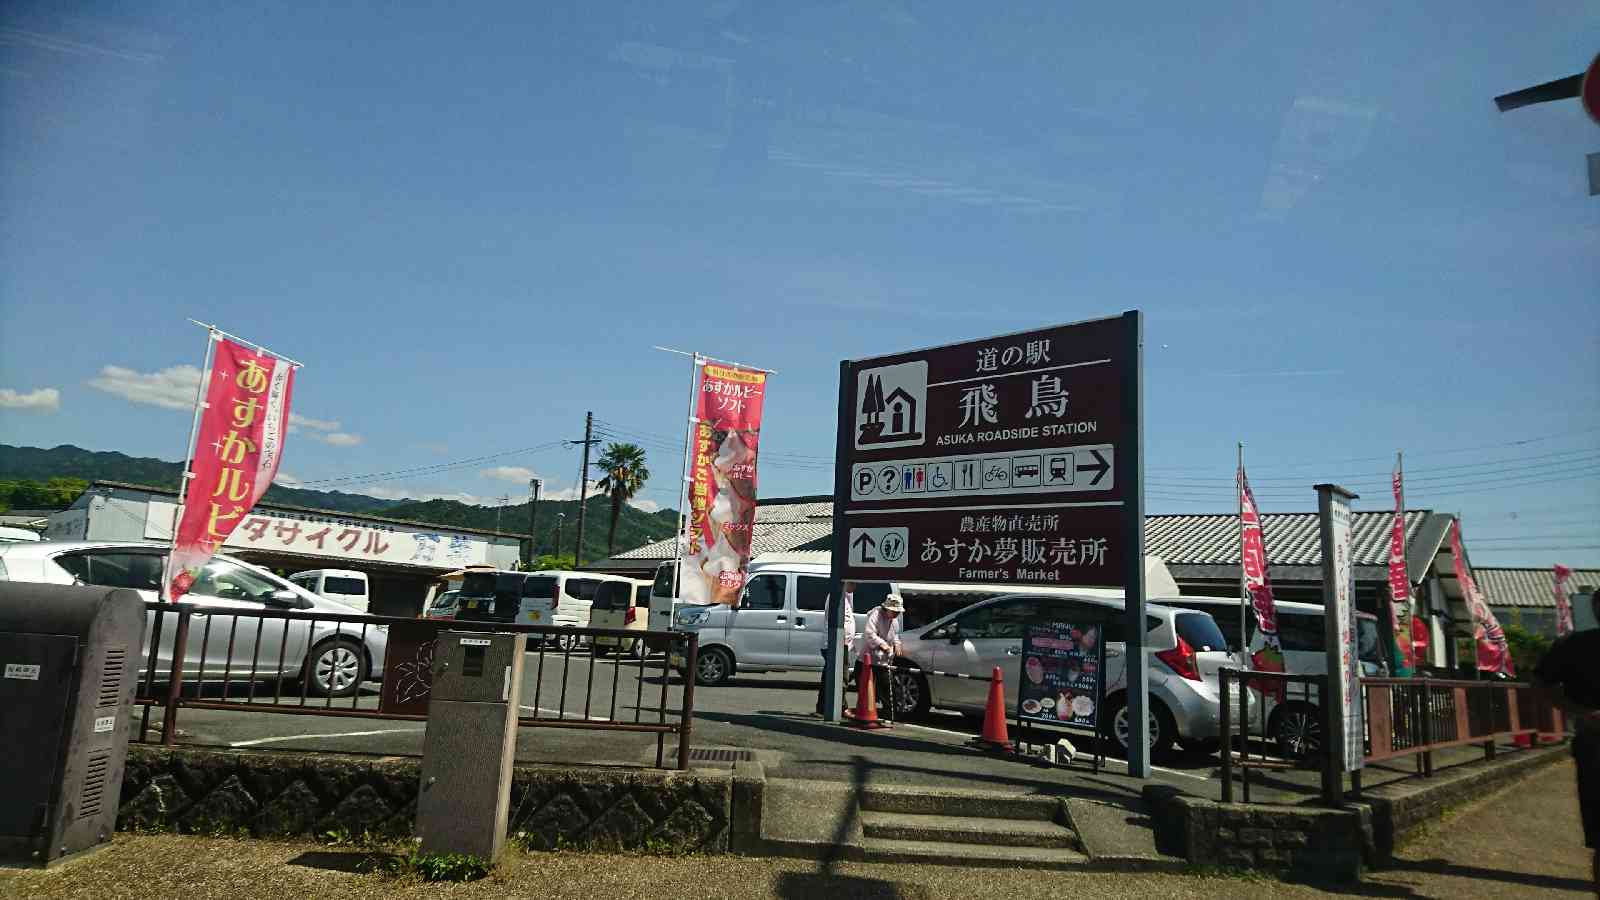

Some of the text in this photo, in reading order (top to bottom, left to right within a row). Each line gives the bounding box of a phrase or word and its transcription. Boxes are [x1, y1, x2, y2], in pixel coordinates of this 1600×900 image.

[976, 338, 1051, 373] 道の駅
[703, 378, 762, 399] あすかルビー
[717, 396, 746, 413] ソフト
[958, 374, 1070, 429] 飛鳥
[936, 421, 1098, 446] ASUKA ROADSIDE STATION
[959, 514, 1060, 534] 農産物直売所
[920, 537, 1109, 567] あすか夢販売所
[959, 568, 1061, 581] Farmer's Market
